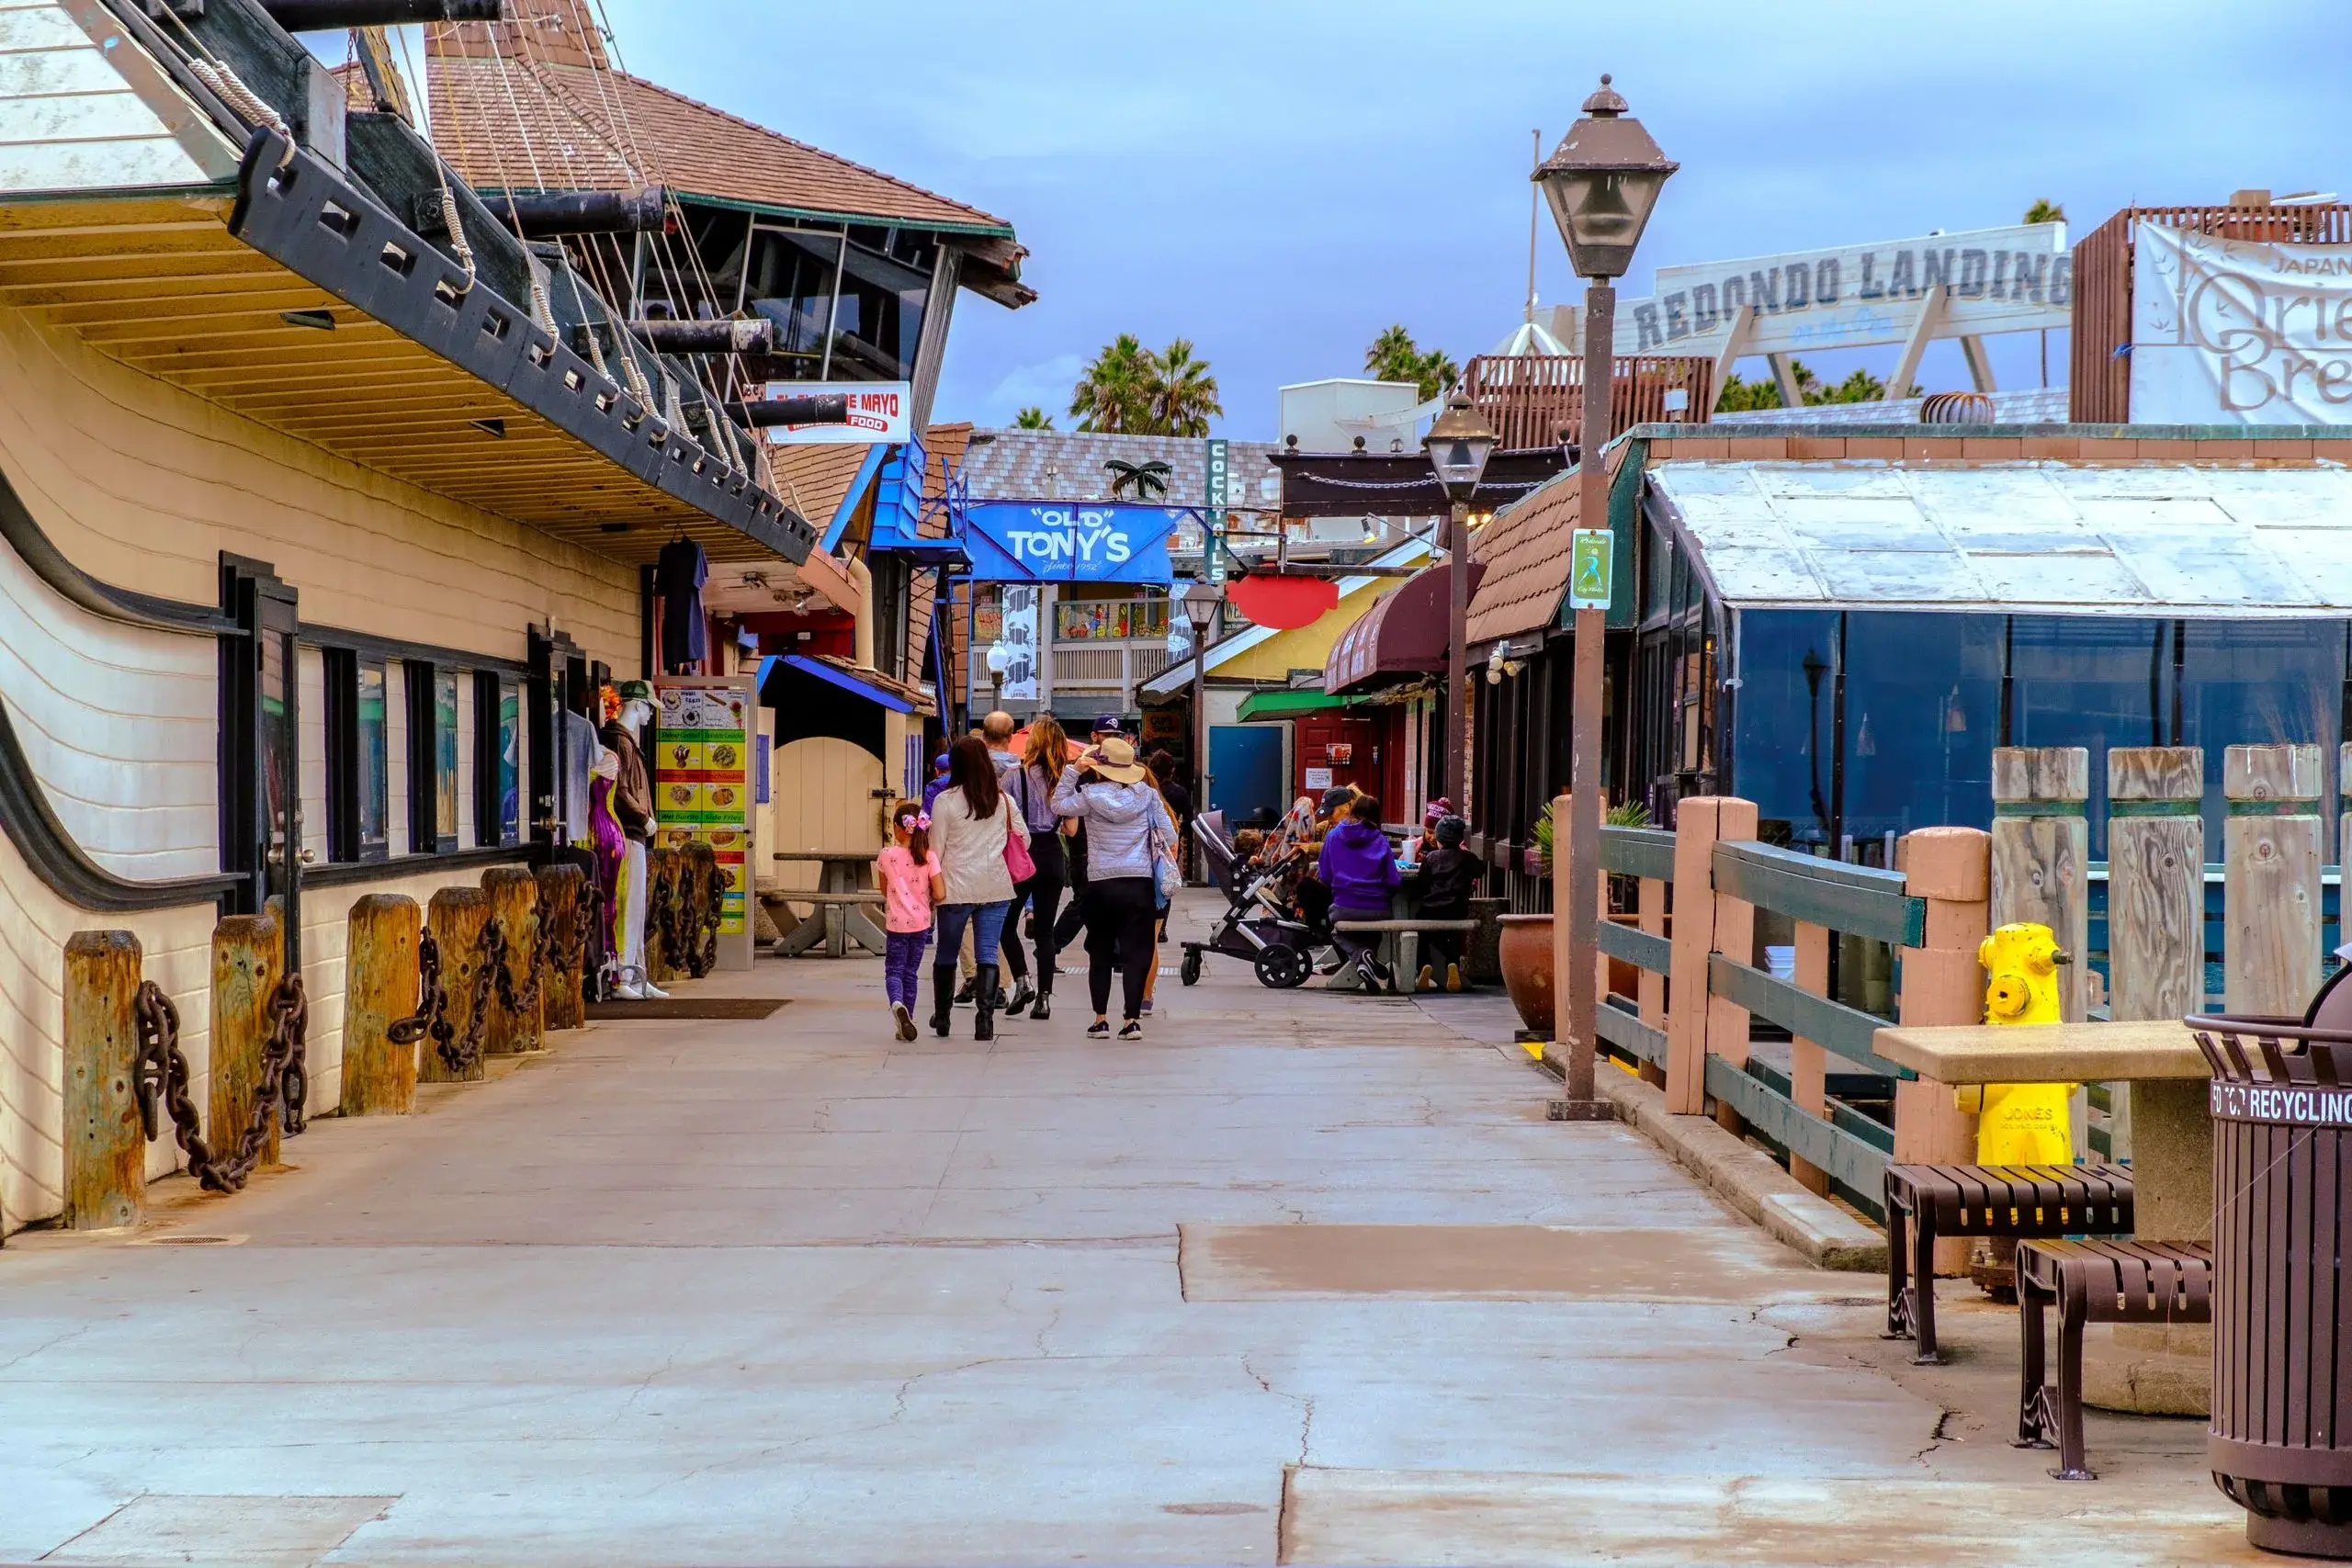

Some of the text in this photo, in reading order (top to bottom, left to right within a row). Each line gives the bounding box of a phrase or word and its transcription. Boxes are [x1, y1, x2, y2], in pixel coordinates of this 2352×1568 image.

[1633, 257, 1841, 353] REDONDO
[1860, 248, 2072, 306] LANDING
[2218, 328, 2352, 412] Bre
[850, 416, 884, 430] FOOD
[861, 393, 899, 417] MAYO
[1211, 444, 1225, 581] COCKTAILS
[1007, 524, 1131, 563] TONY'S
[2250, 1089, 2352, 1123] RECYCLING
